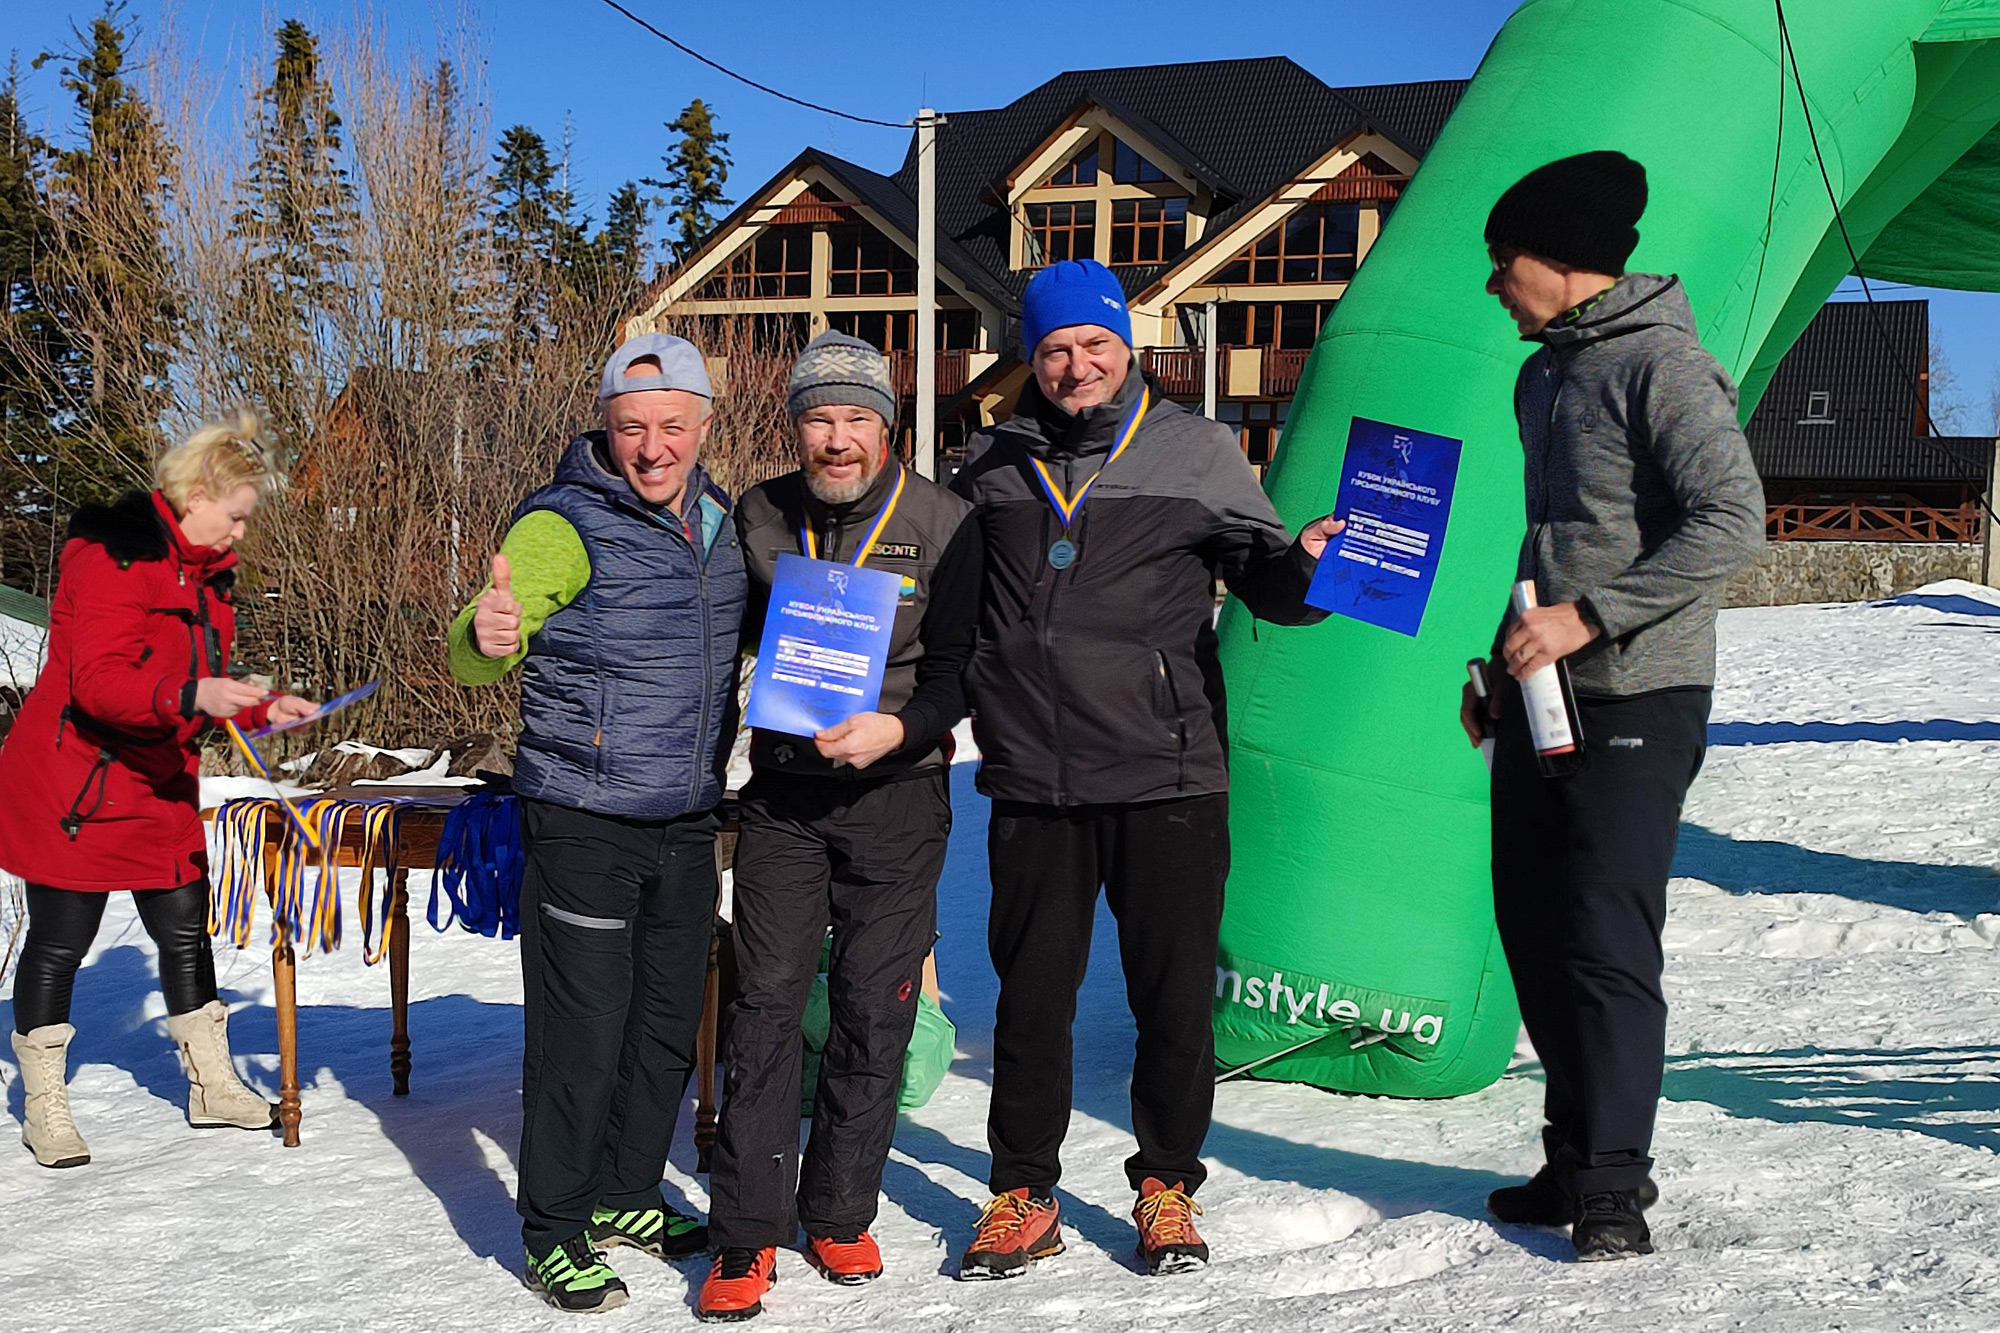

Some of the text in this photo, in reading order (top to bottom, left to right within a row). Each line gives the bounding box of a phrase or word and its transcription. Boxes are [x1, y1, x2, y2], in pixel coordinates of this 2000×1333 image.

[1357, 470, 1437, 496] КУБОК УКРАЇНСЬКОГО
[1416, 494, 1441, 506] КЛУБУ
[789, 600, 815, 611] КУБОК
[853, 621, 881, 632] КЛУБУ
